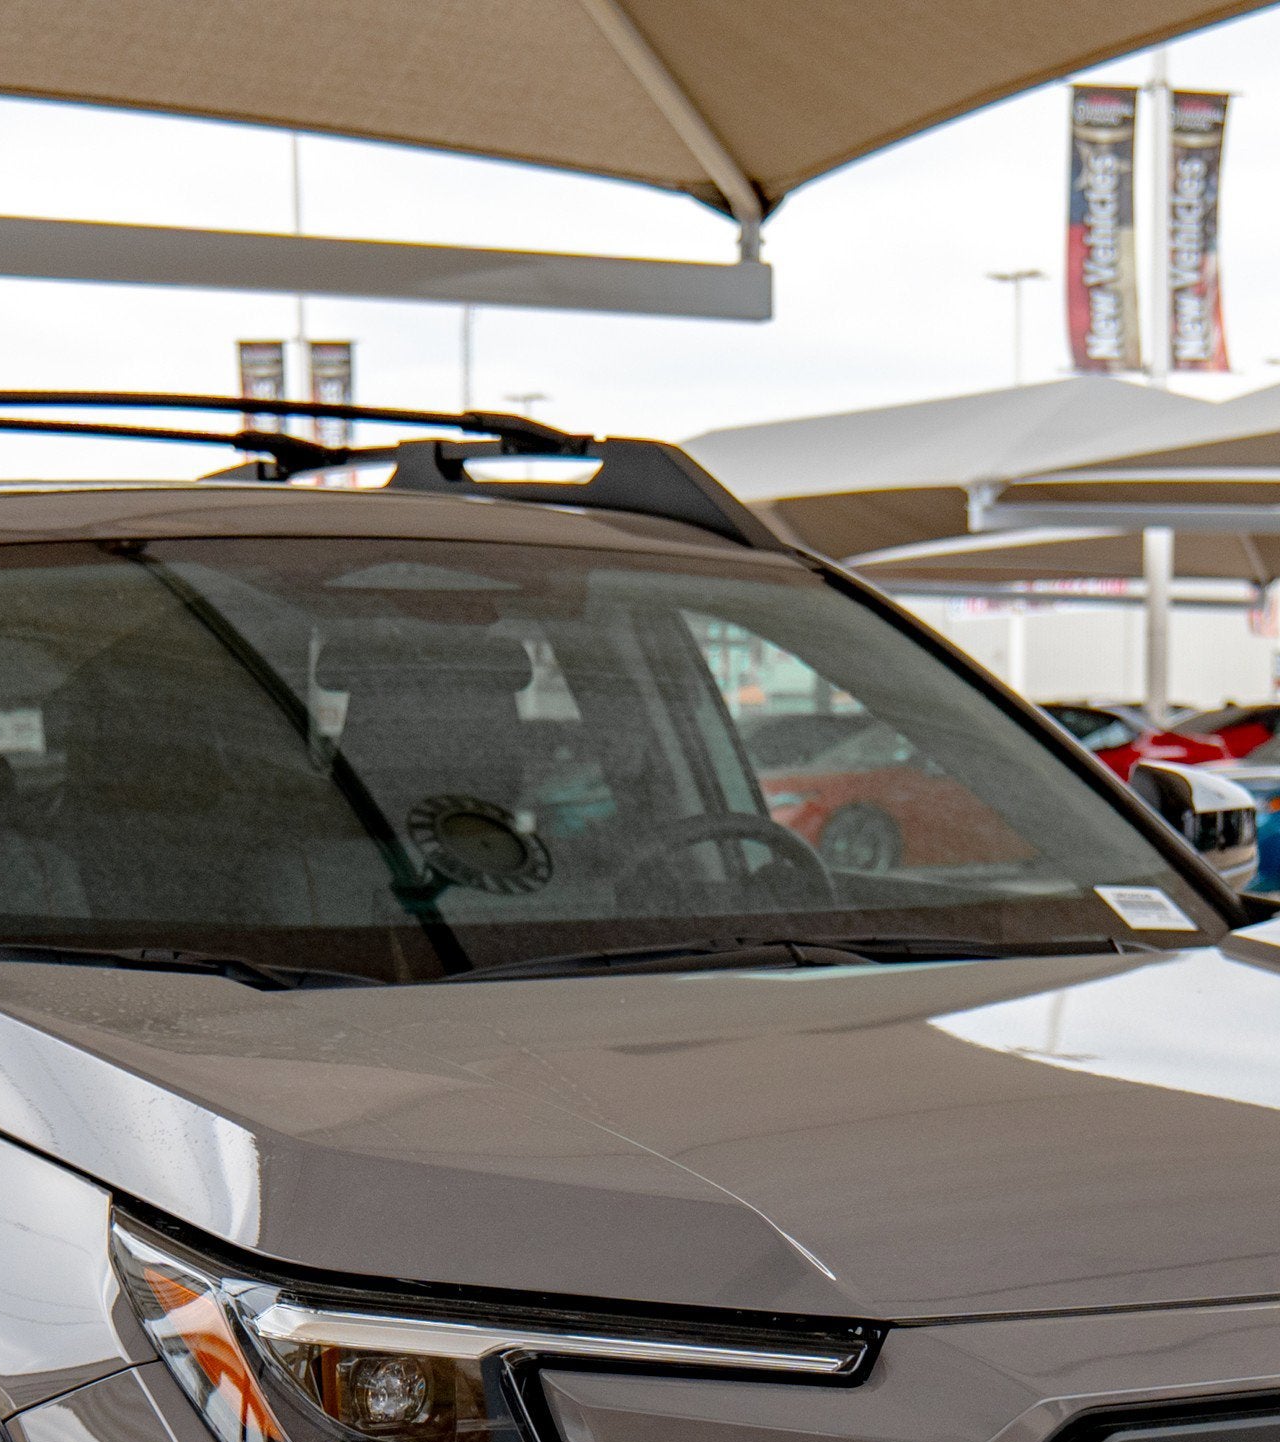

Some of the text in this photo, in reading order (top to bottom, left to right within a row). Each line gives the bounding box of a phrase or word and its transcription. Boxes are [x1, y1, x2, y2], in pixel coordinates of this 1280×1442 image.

[1082, 152, 1120, 286] Vehicles
[1170, 157, 1208, 289] Vehicles
[1086, 290, 1121, 360] New
[1174, 294, 1211, 361] New
